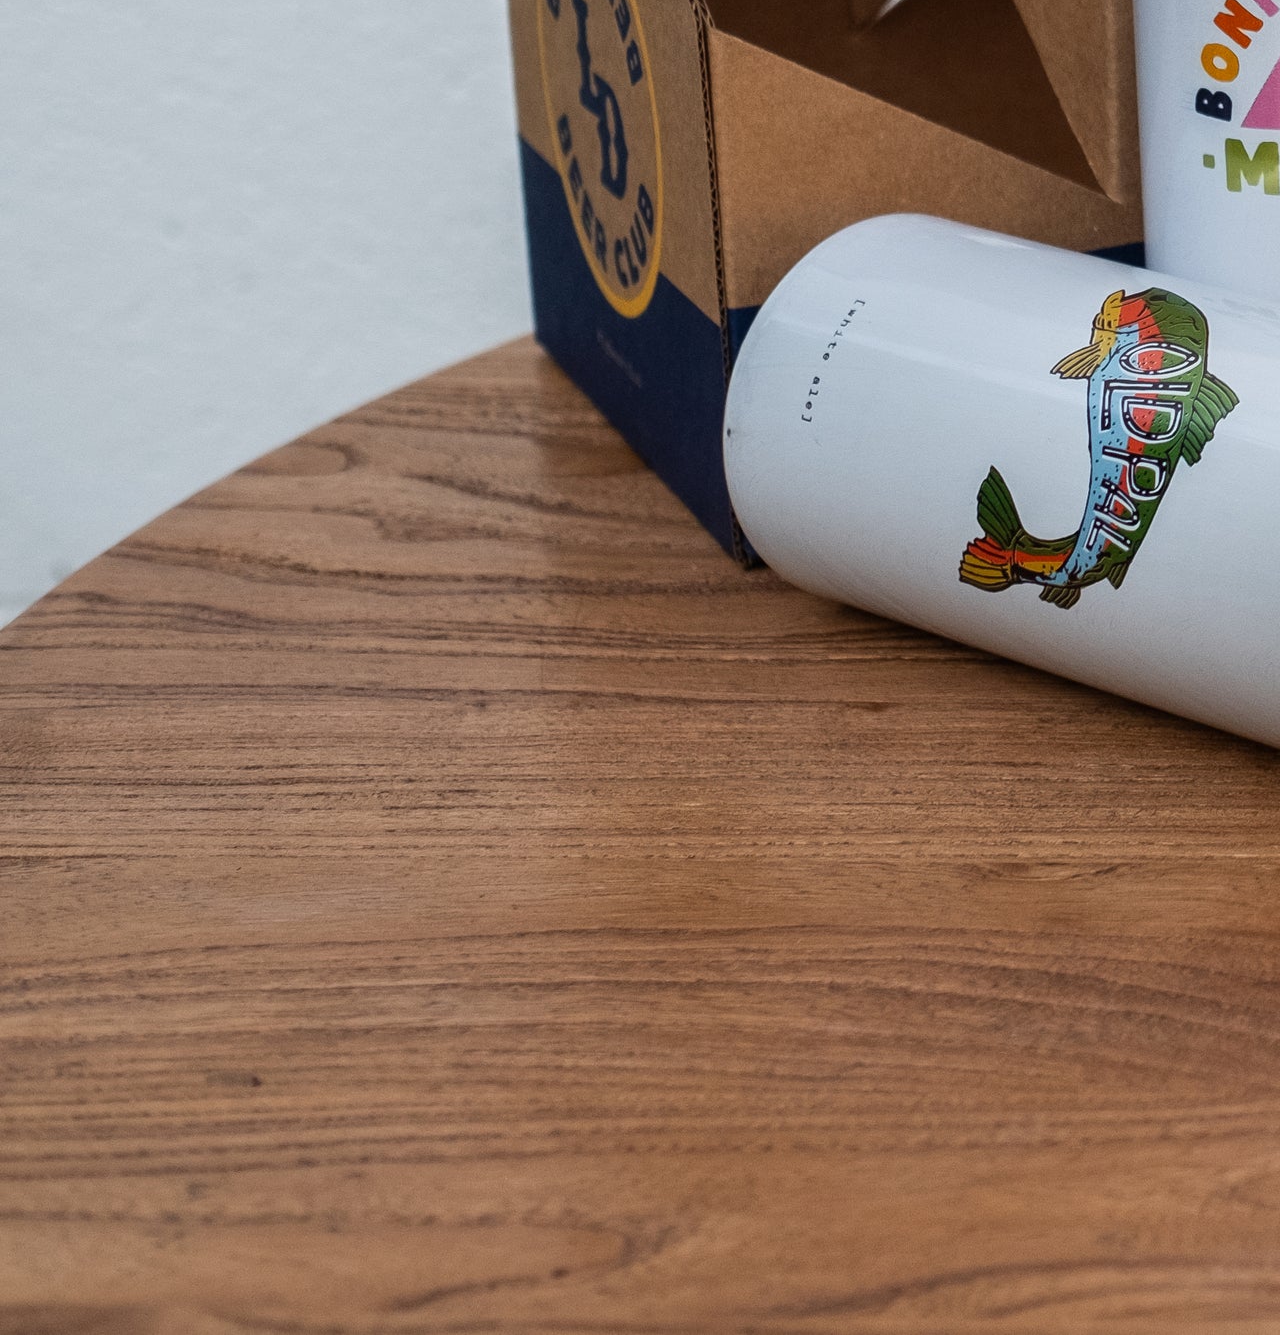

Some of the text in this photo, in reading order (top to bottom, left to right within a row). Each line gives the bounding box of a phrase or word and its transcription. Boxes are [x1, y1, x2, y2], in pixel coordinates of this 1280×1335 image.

[557, 113, 654, 290] BEER CLUB
[1085, 341, 1203, 554] OLD PAL
